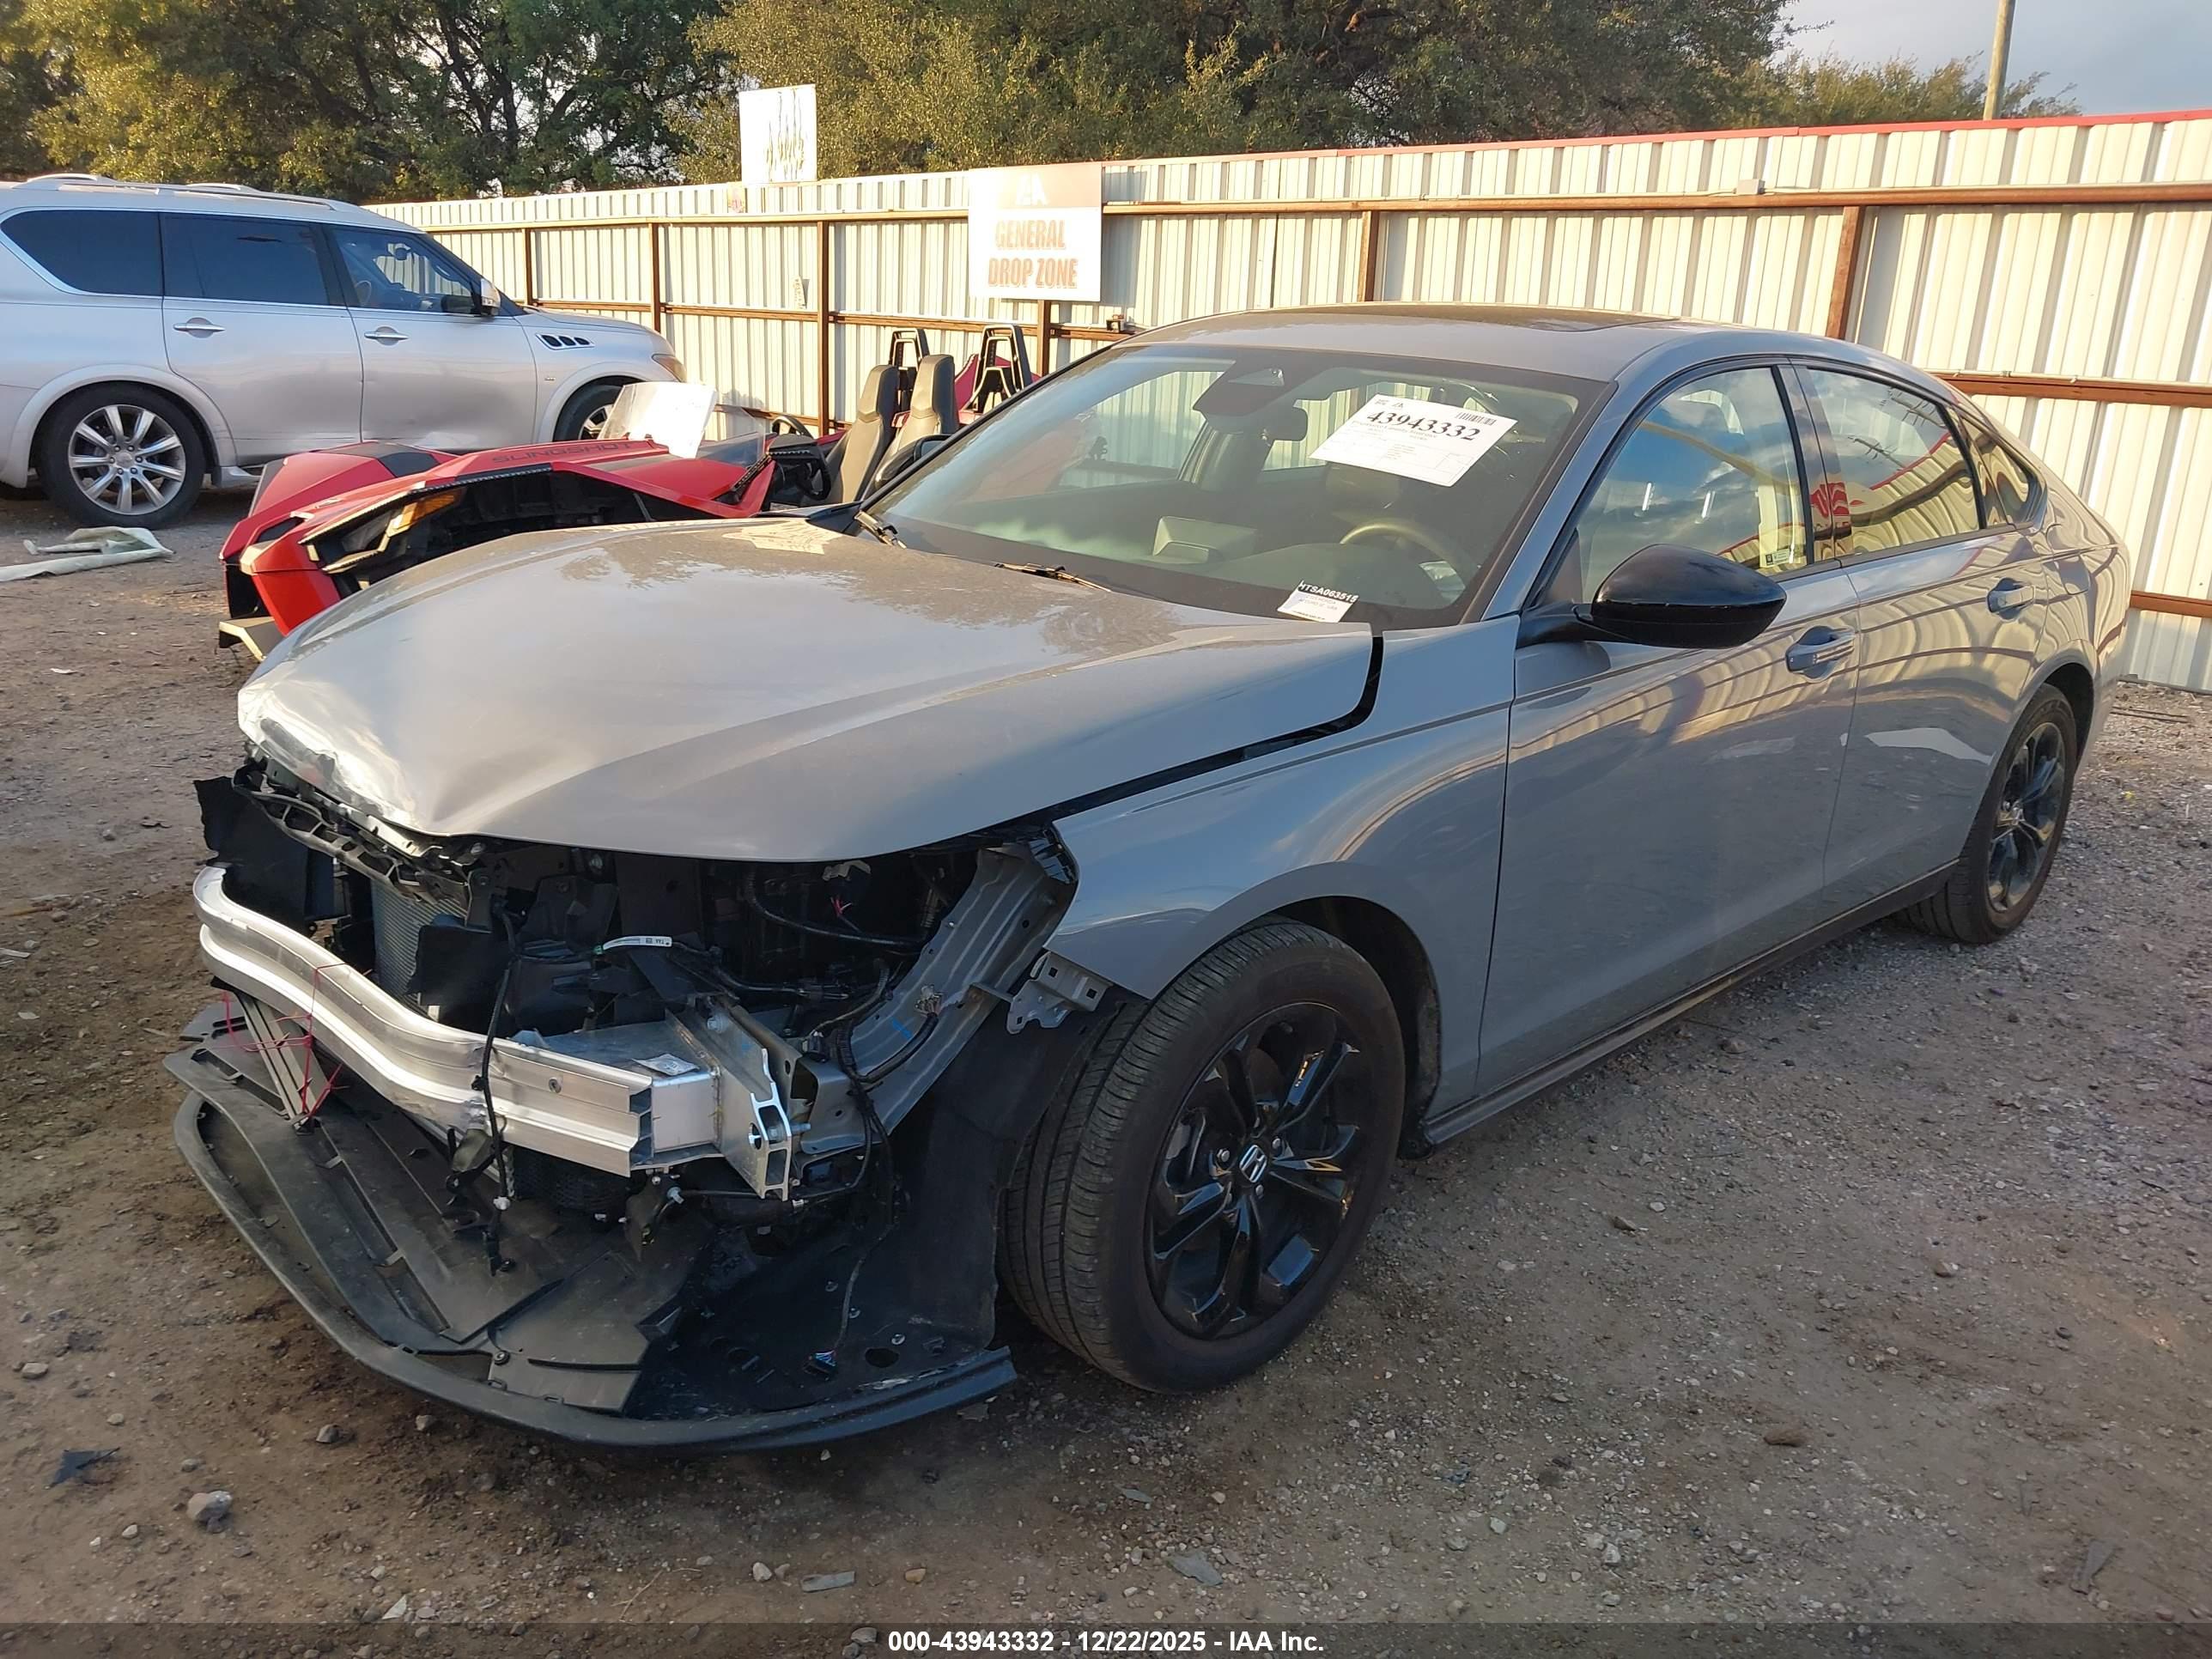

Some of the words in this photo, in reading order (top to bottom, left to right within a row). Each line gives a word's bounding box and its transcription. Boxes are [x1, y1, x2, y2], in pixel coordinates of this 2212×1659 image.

[995, 219, 1066, 250] GENERAL
[988, 258, 1034, 288] DROP
[1035, 258, 1079, 289] ZONE
[1367, 410, 1481, 441] 43943332
[492, 442, 633, 463] SLINGSHOT
